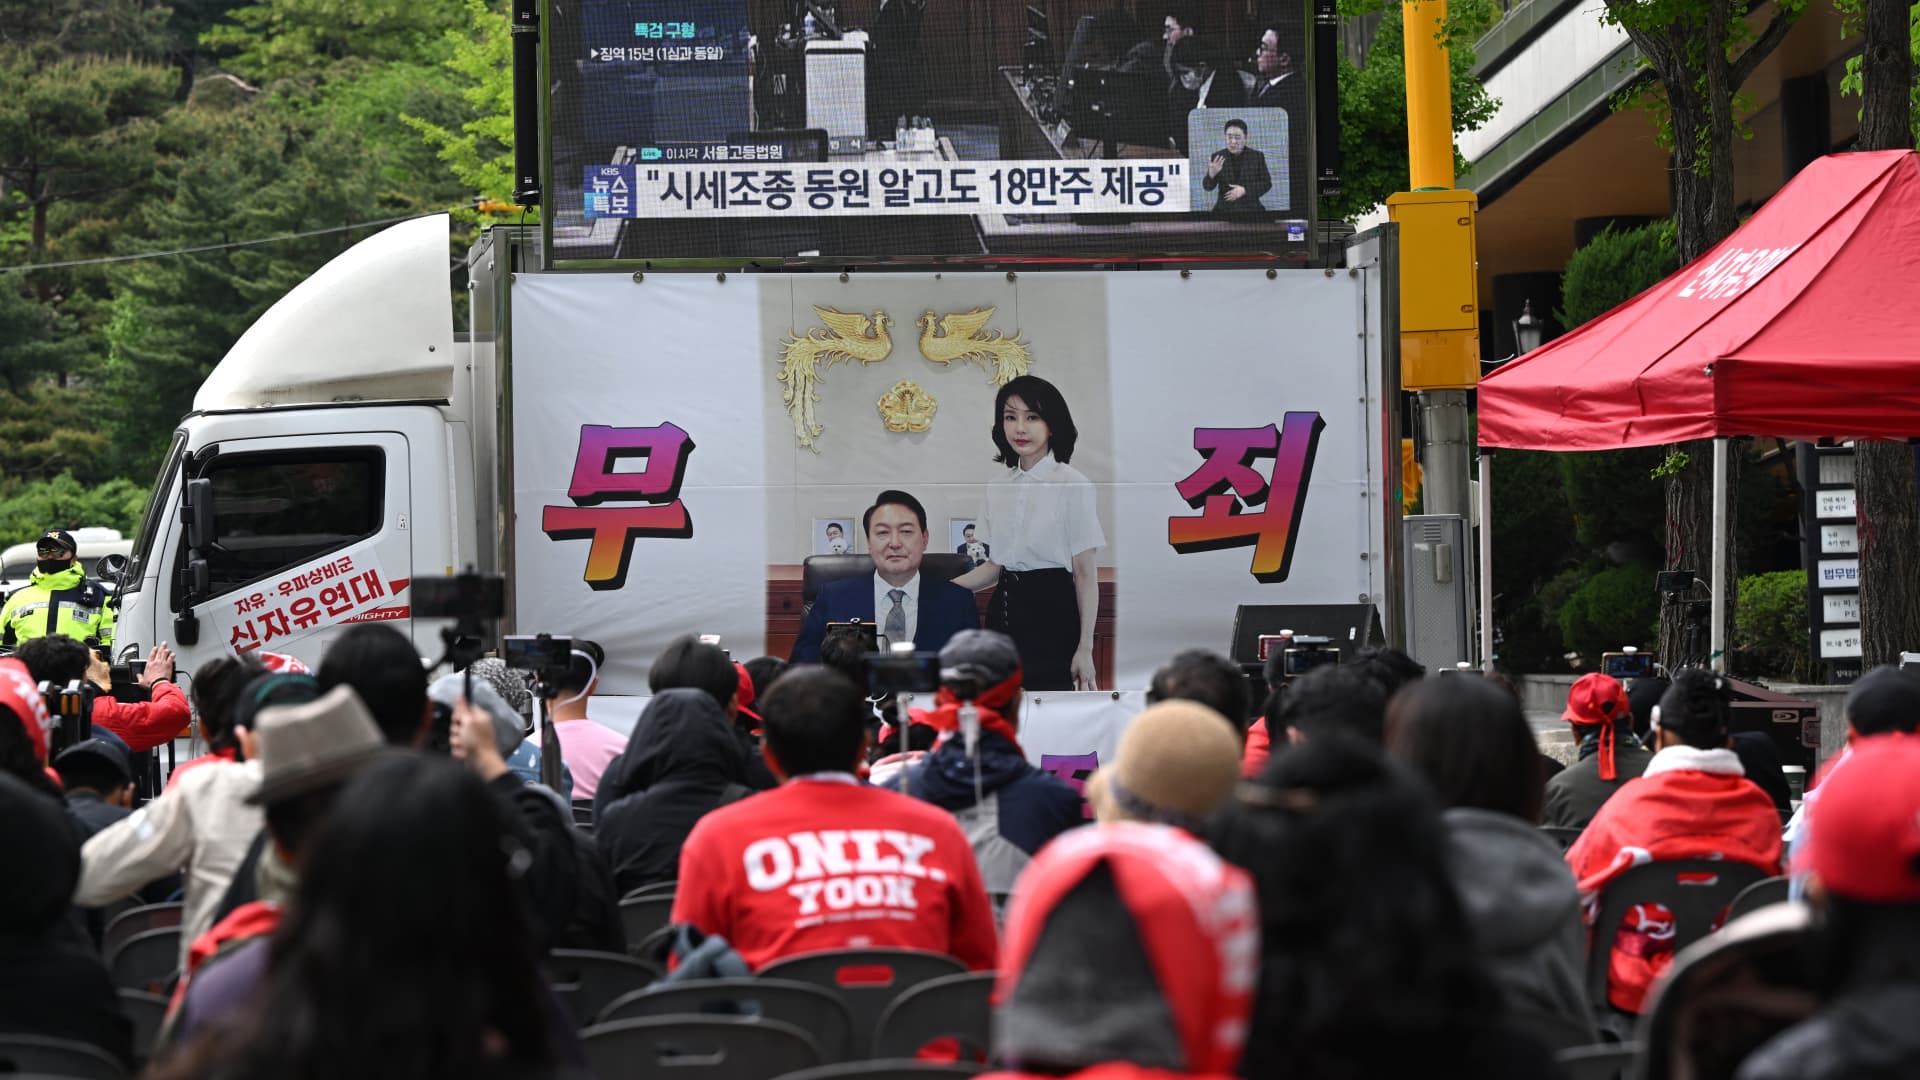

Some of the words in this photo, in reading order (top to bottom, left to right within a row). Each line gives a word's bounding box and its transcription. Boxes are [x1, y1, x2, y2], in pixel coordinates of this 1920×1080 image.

[634, 22, 663, 39] 특검
[666, 22, 696, 39] 구형
[600, 47, 625, 62] 징역
[628, 46, 654, 61] 15년
[656, 47, 693, 62] (1심과
[694, 46, 724, 61] 동일)
[666, 148, 698, 160] 이시각
[702, 145, 783, 161] 서울고등법원
[600, 167, 620, 176] KBS
[592, 175, 629, 194] 뉴스
[647, 169, 796, 211] "시세조종
[804, 168, 869, 210] 동원
[879, 168, 980, 209] 알고도
[989, 167, 1093, 207] 18만주
[1100, 163, 1180, 206] 제공"
[593, 195, 629, 215] 특보
[542, 421, 696, 591] 무
[1168, 411, 1327, 584] 죄
[1823, 567, 1859, 581] 법무법
[234, 593, 266, 616] 자유
[277, 555, 355, 598] 우파상비군
[229, 568, 386, 656] 신자유연대
[350, 609, 404, 622] MIGHTY
[788, 875, 919, 915] YOON
